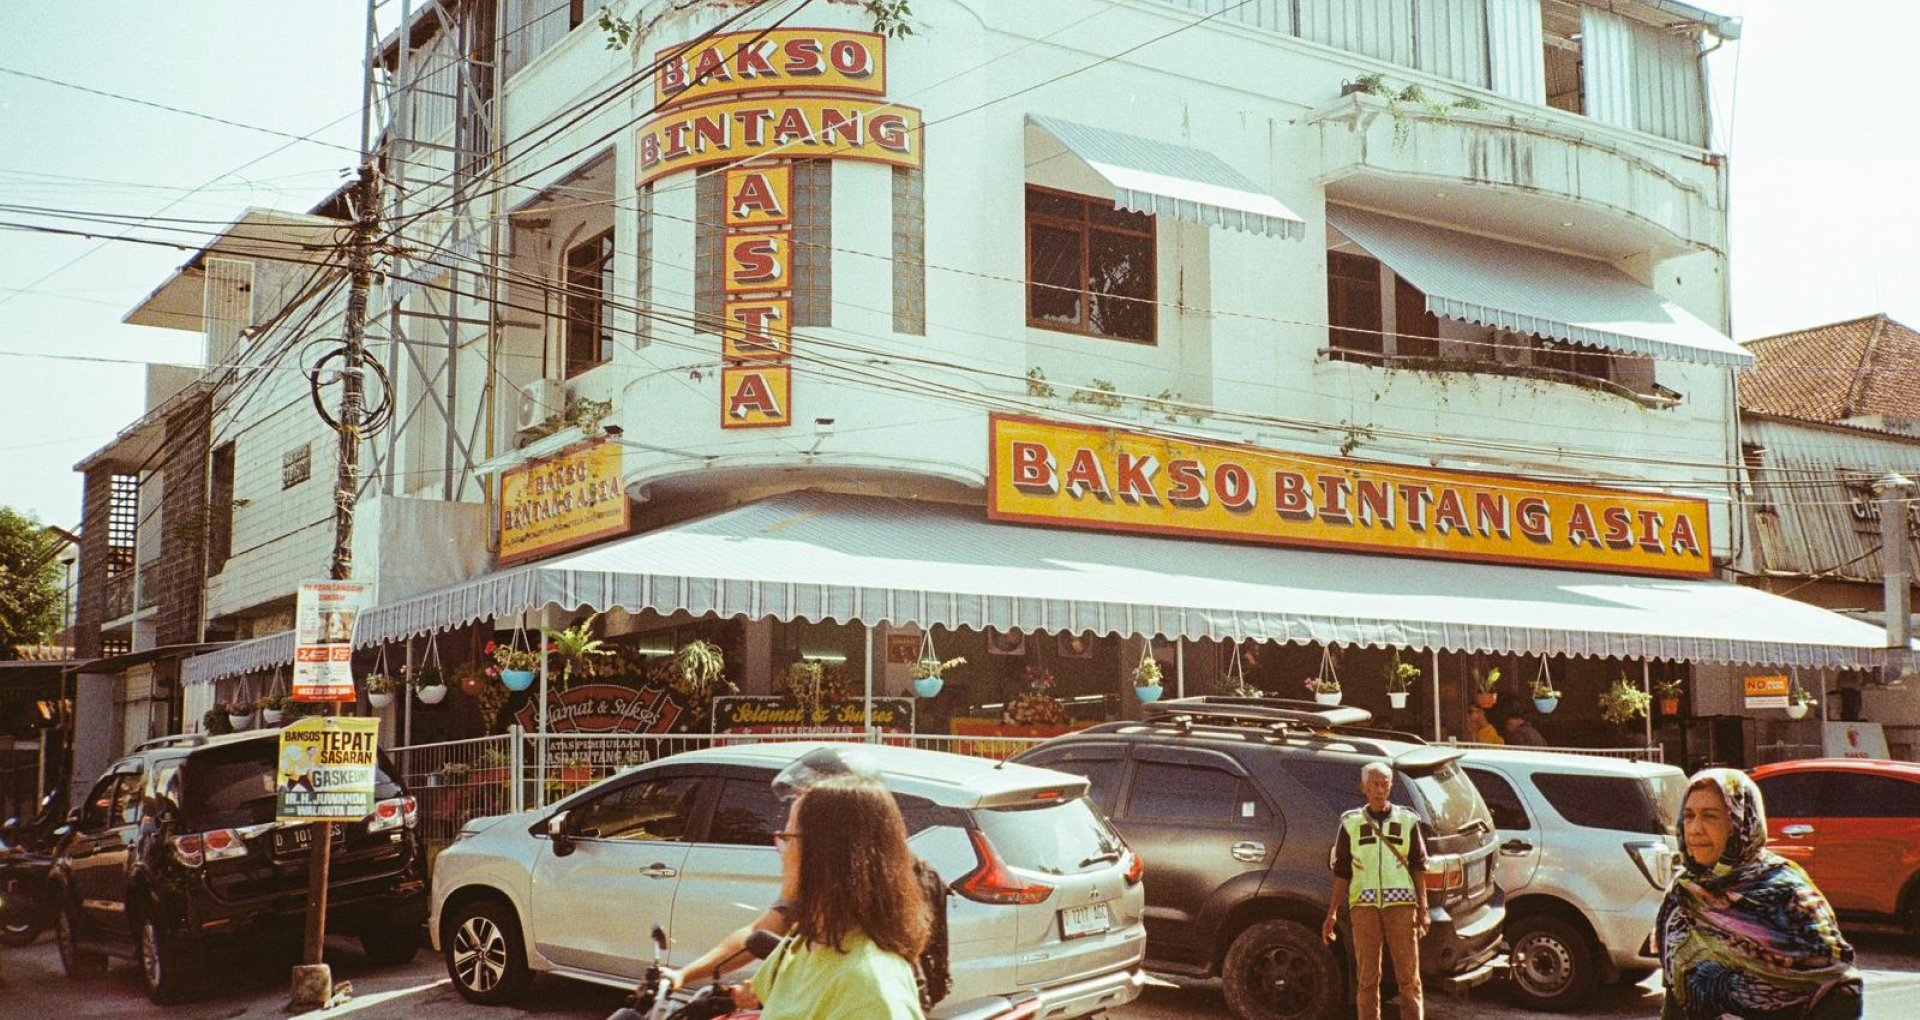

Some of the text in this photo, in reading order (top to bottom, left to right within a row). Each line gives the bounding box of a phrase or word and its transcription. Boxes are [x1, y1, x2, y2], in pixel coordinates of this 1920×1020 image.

[661, 38, 874, 96] BAKSO
[640, 107, 911, 170] BINTANG
[729, 173, 786, 420] ASIA
[535, 460, 586, 496] BAKSO
[1012, 440, 1704, 558] BAKSO BINTANG ASIA
[597, 700, 608, 714] &
[285, 731, 374, 750] BANSOS TEPAT
[321, 751, 372, 763] SASARAN
[313, 793, 366, 805] JUWANDA
